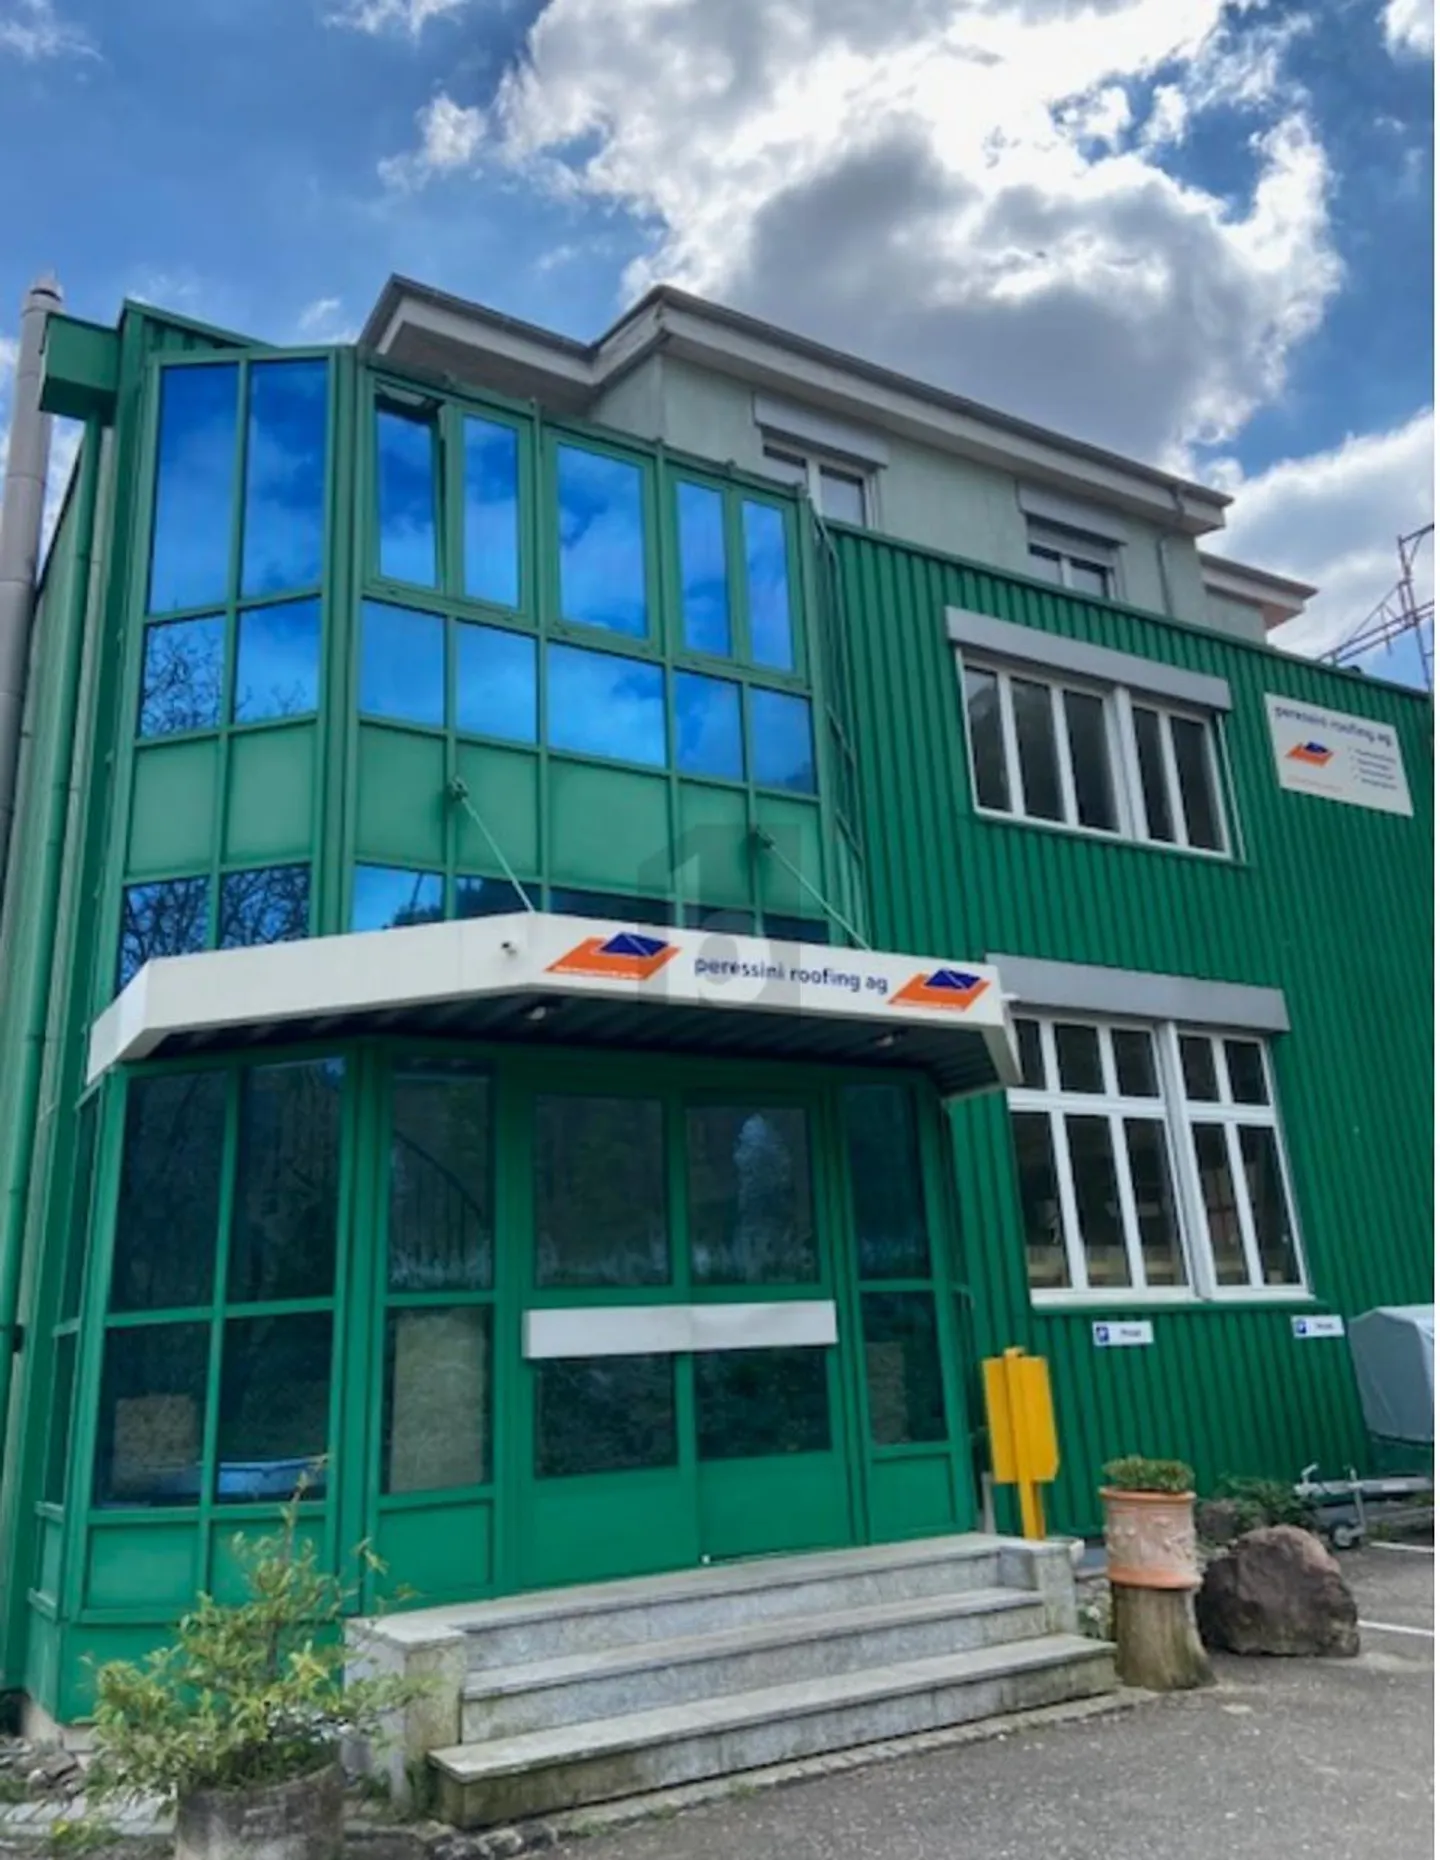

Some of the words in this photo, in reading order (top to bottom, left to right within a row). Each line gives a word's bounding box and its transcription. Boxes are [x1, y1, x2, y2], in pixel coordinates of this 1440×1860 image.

[694, 958, 786, 981] peressini
[789, 966, 861, 993] roofing
[865, 975, 889, 995] ag
